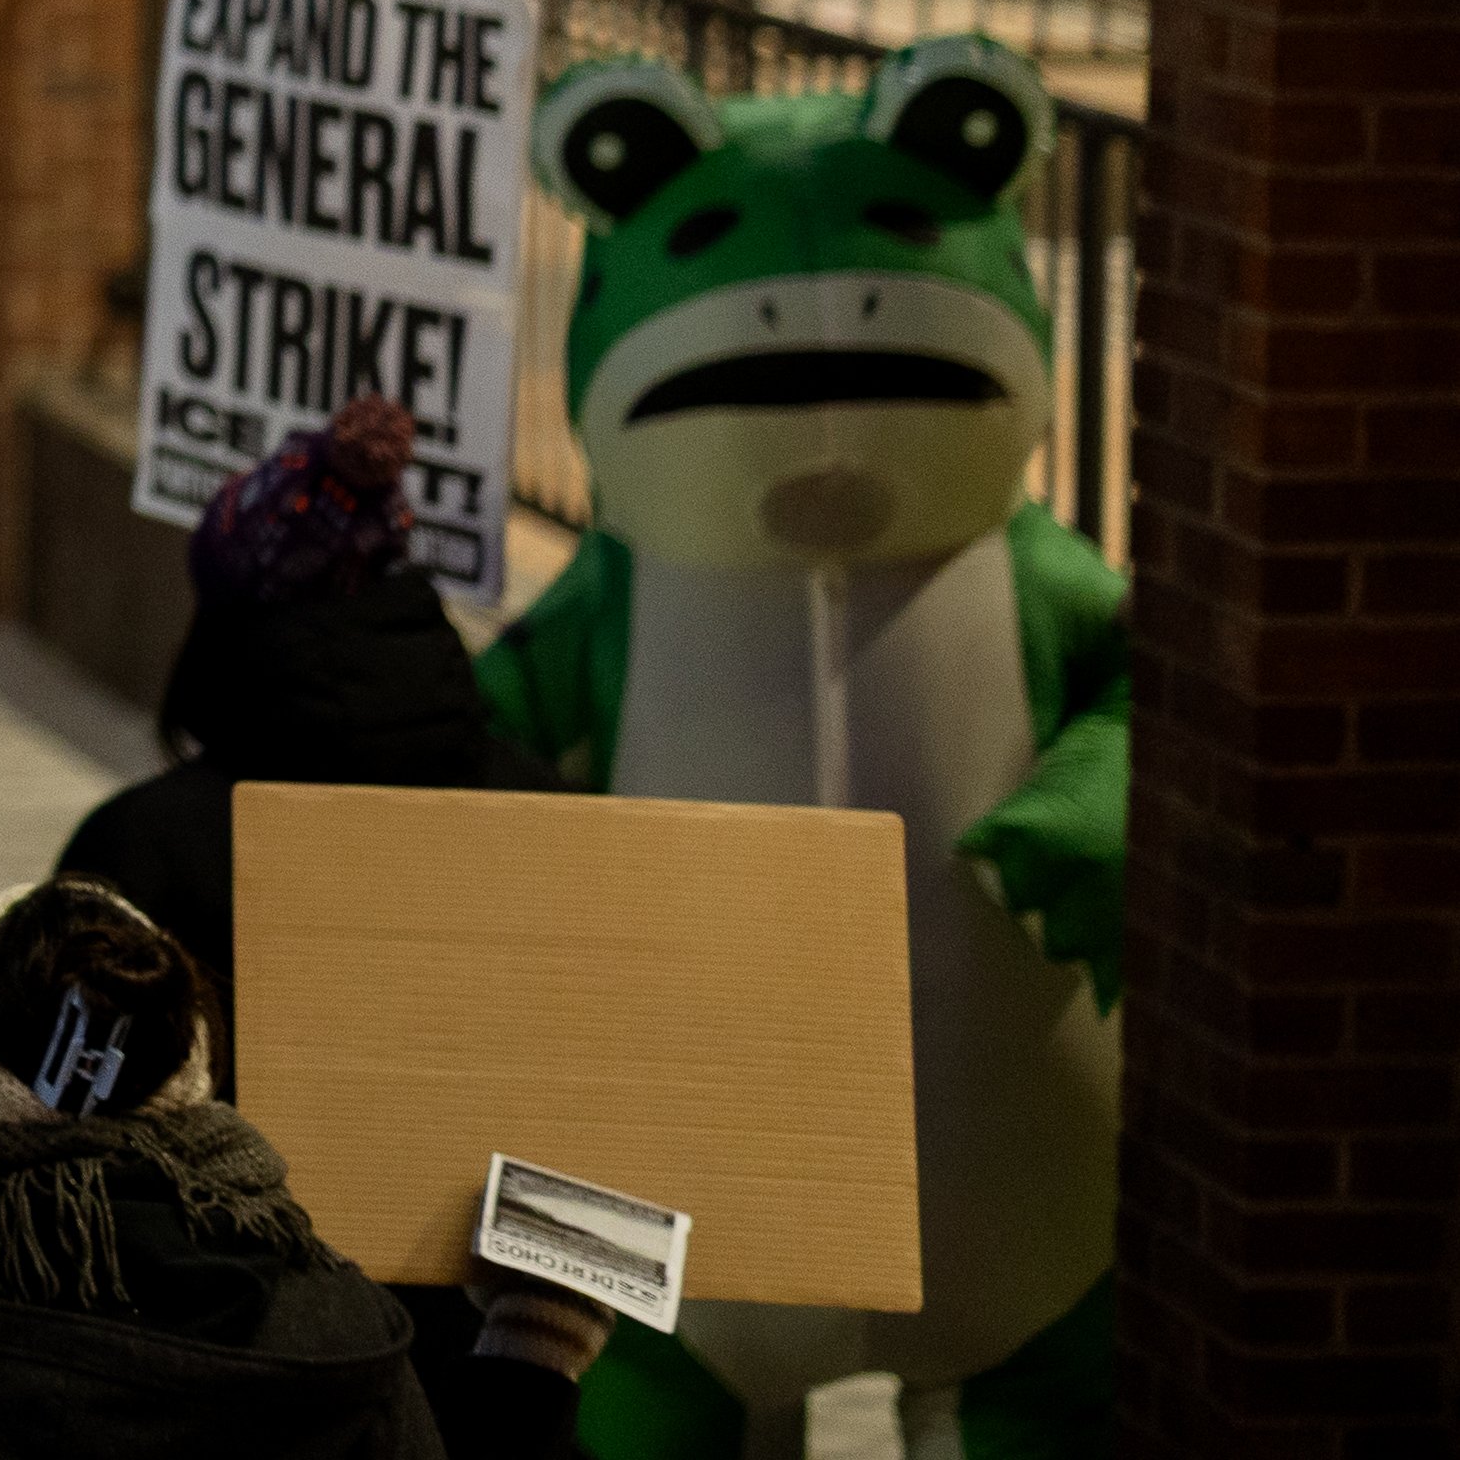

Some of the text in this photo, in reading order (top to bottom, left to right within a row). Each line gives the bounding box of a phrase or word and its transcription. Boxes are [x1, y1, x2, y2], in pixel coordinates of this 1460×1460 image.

[395, 0, 504, 114] THE
[171, 70, 493, 264] GENERAL
[182, 251, 468, 445] STRIKE!
